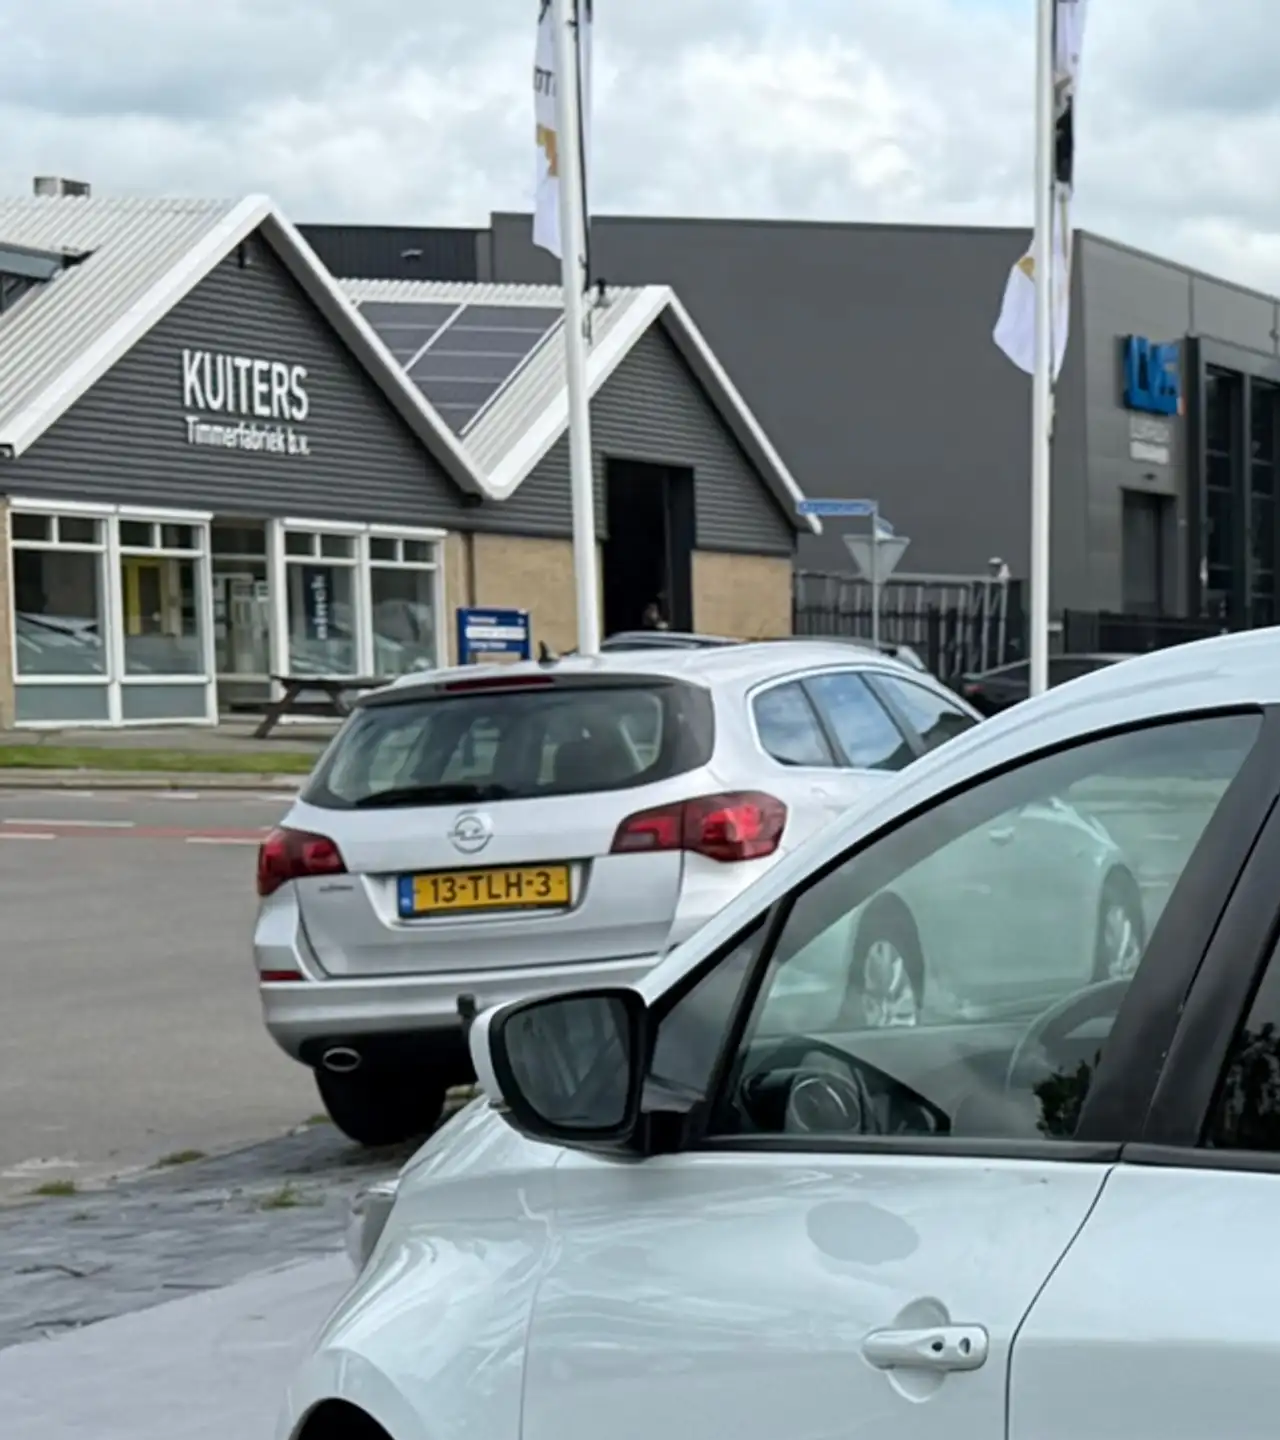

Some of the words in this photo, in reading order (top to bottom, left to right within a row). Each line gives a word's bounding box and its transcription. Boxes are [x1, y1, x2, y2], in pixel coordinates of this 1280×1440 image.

[182, 349, 309, 421] KUITERS
[185, 415, 285, 452] Timmerfabriek
[430, 871, 553, 904] 13-TLH-3
